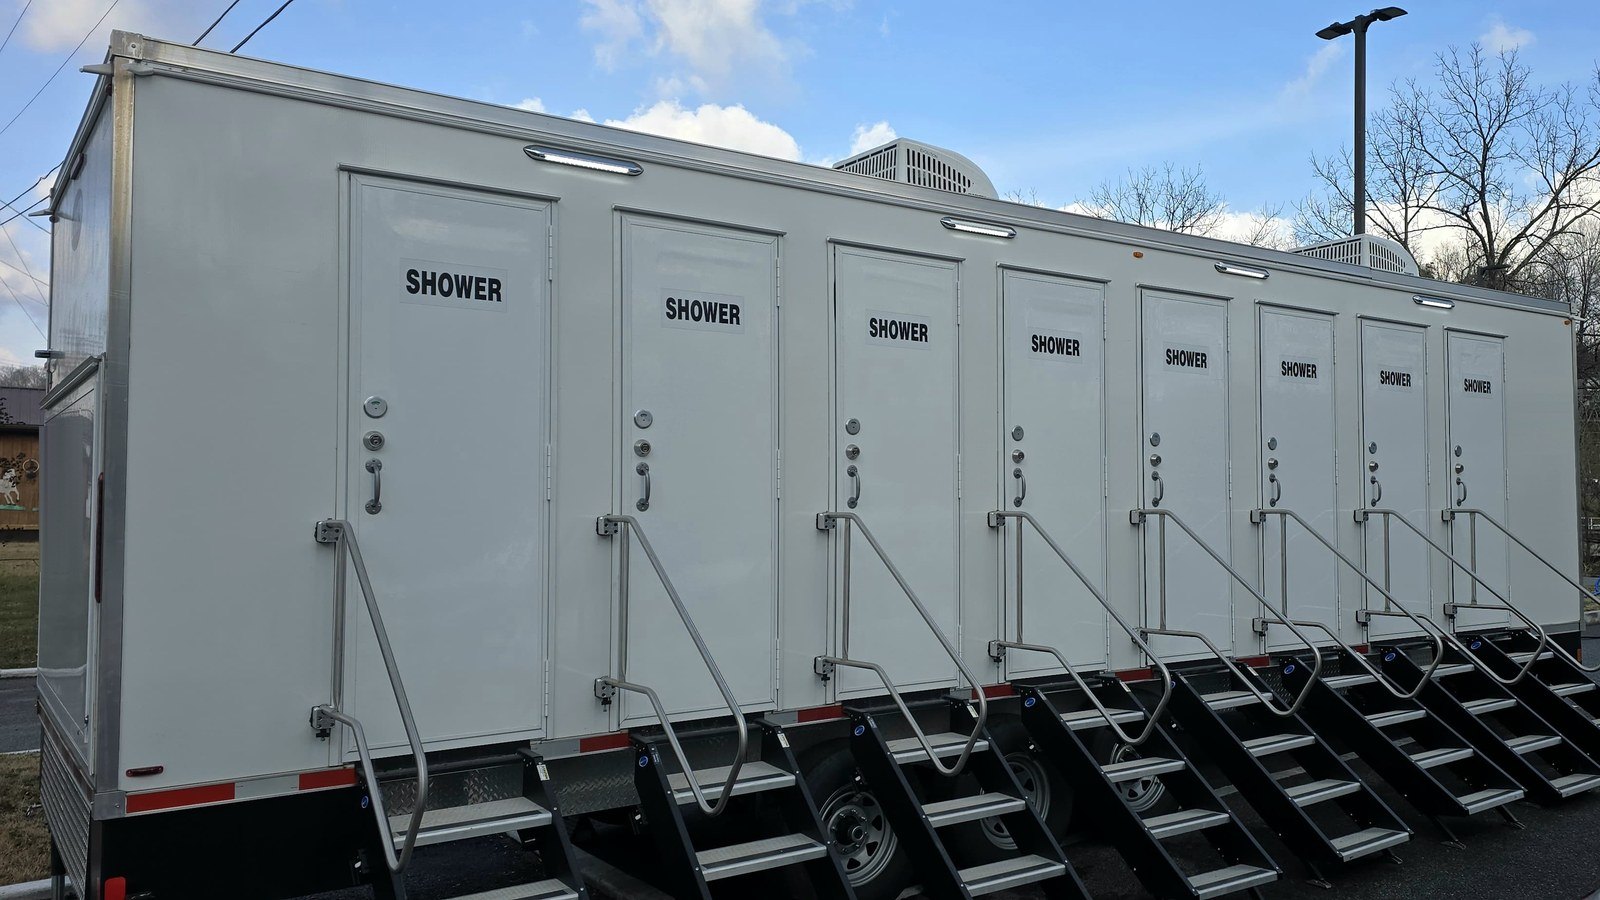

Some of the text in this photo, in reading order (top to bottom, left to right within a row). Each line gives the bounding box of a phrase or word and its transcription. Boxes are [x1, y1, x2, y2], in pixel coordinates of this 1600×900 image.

[406, 269, 501, 302] SHOWER
[666, 298, 740, 325] SHOWER
[870, 318, 928, 342] SHOWER
[1032, 335, 1080, 356] SHOWER
[1166, 349, 1207, 368] SHOWER
[1282, 361, 1317, 378] SHOWER
[1380, 370, 1411, 387] SHOWER
[1464, 379, 1491, 394] SHOWER
